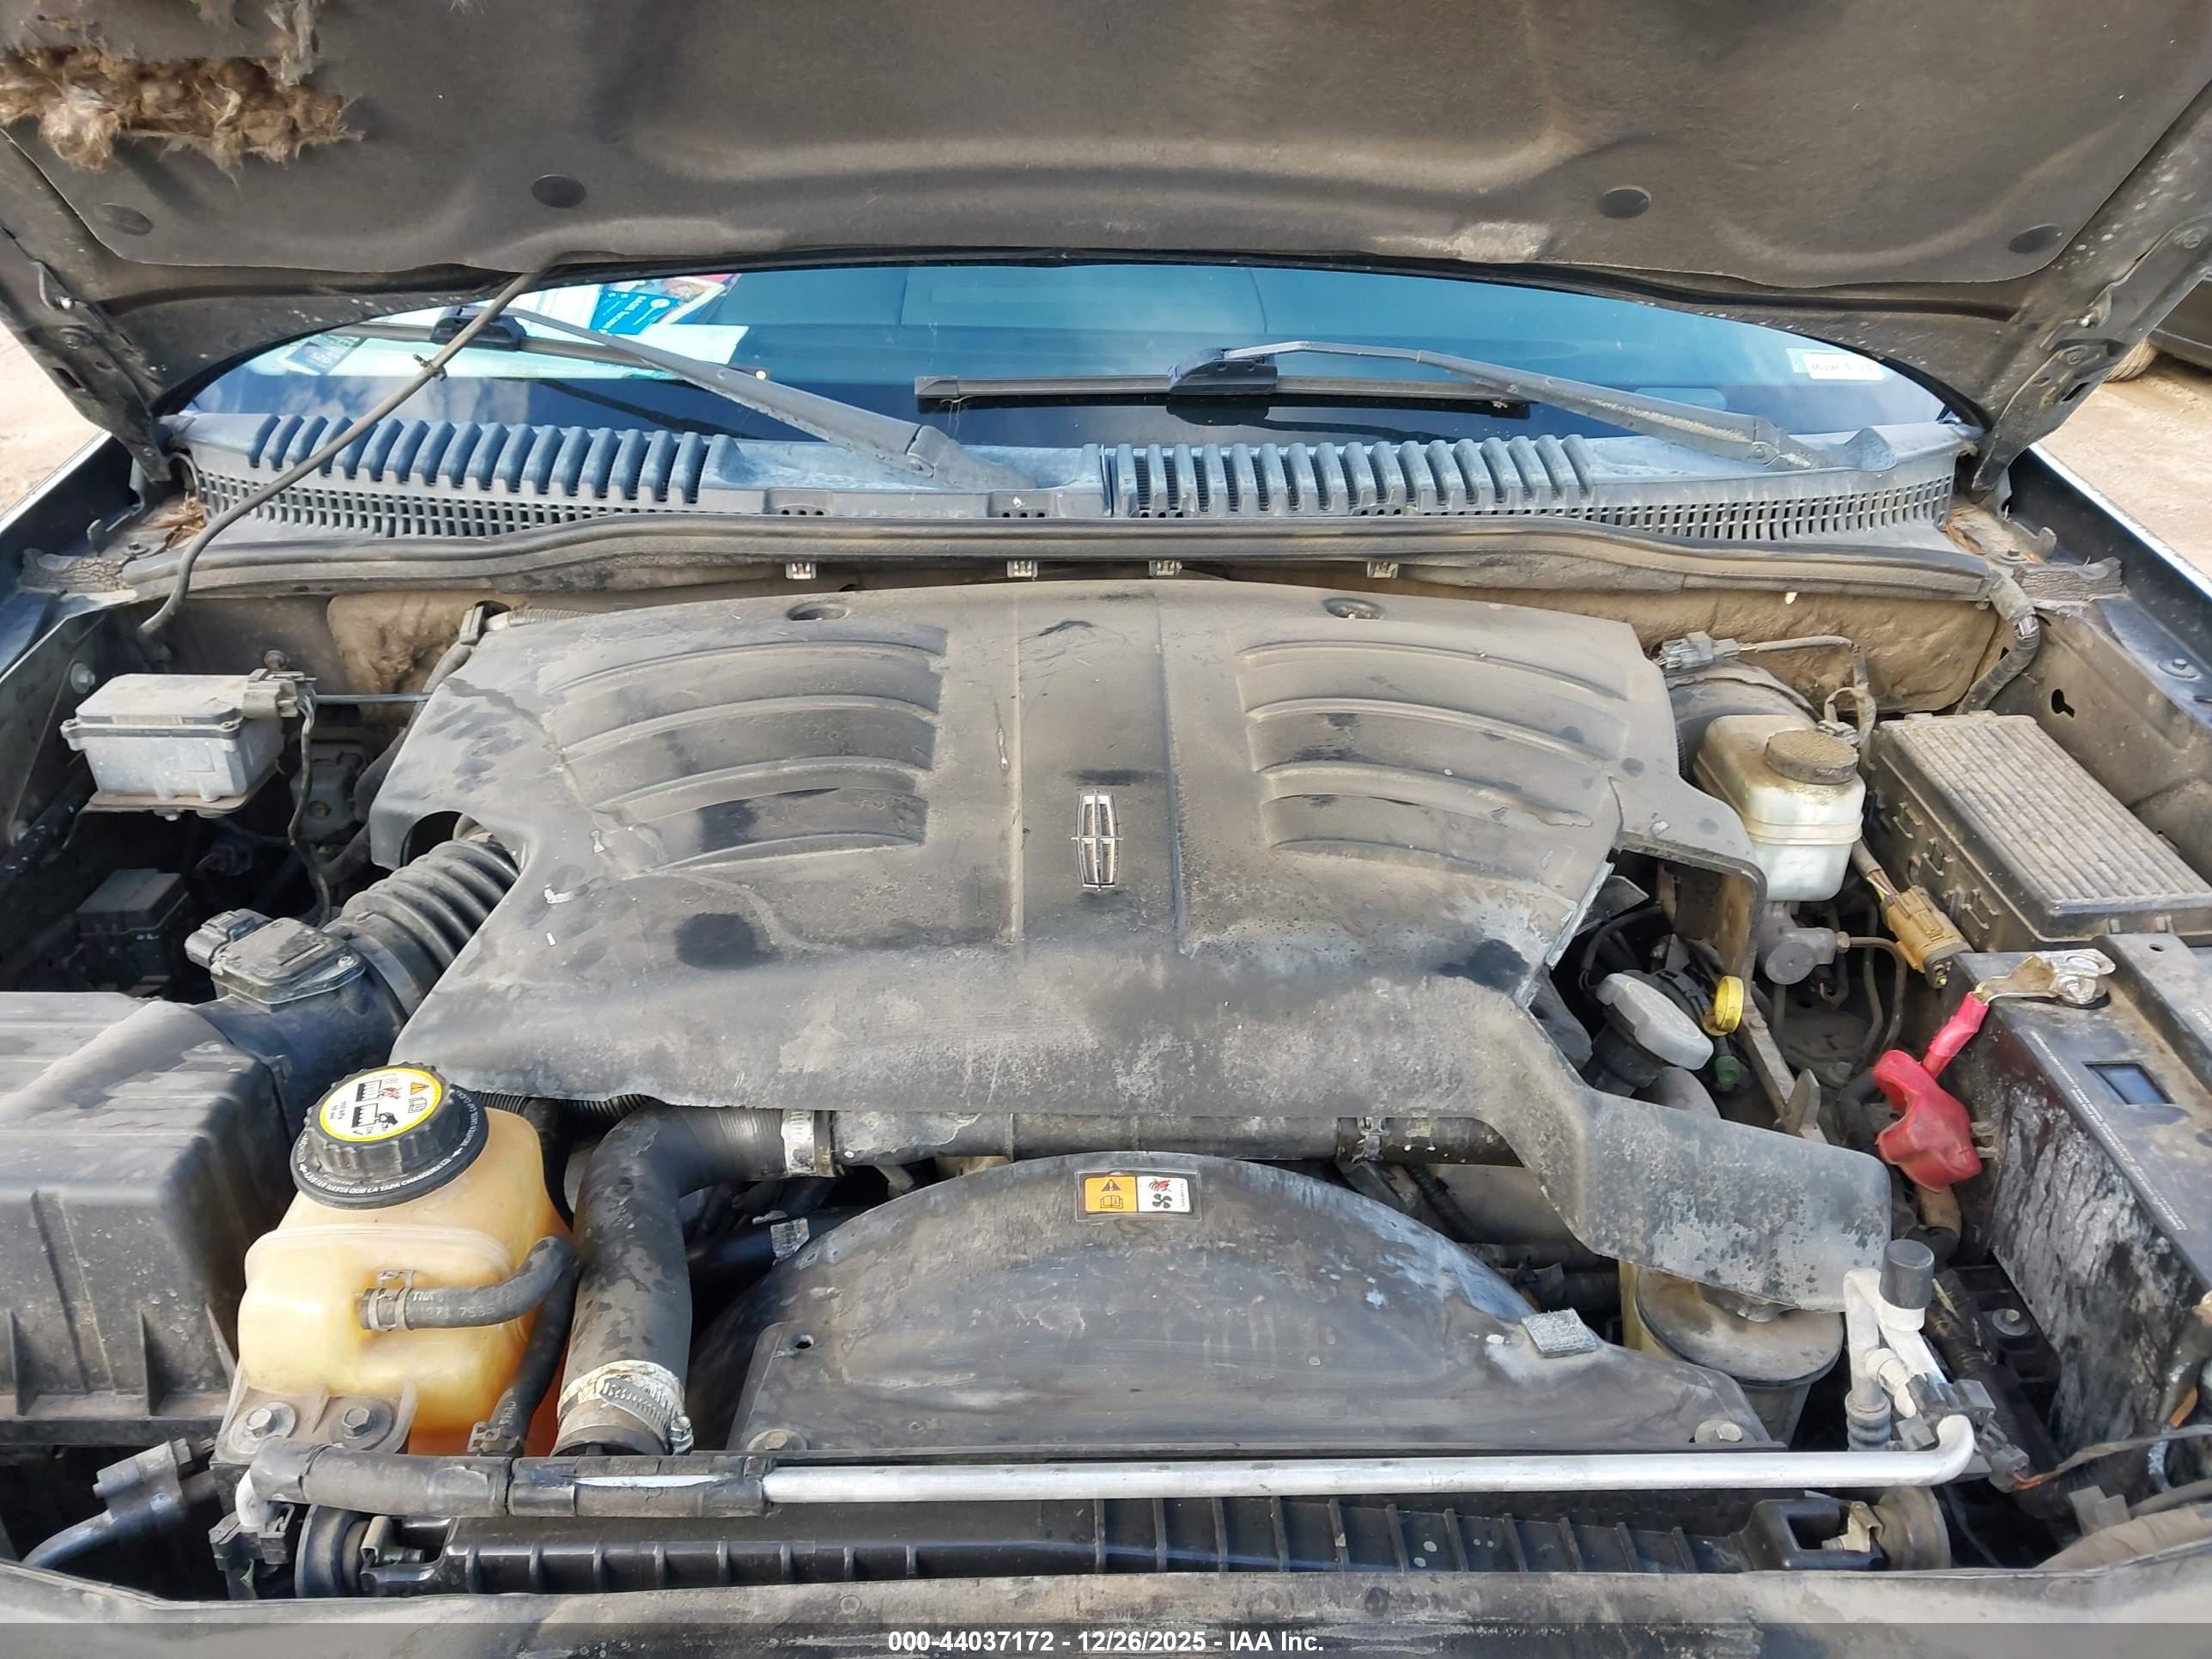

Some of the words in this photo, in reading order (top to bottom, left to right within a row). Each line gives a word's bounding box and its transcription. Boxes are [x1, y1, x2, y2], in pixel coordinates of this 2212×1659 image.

[466, 1103, 477, 1113] CAP
[325, 1183, 349, 1194] HASTA
[379, 1182, 401, 1192] TAPA
